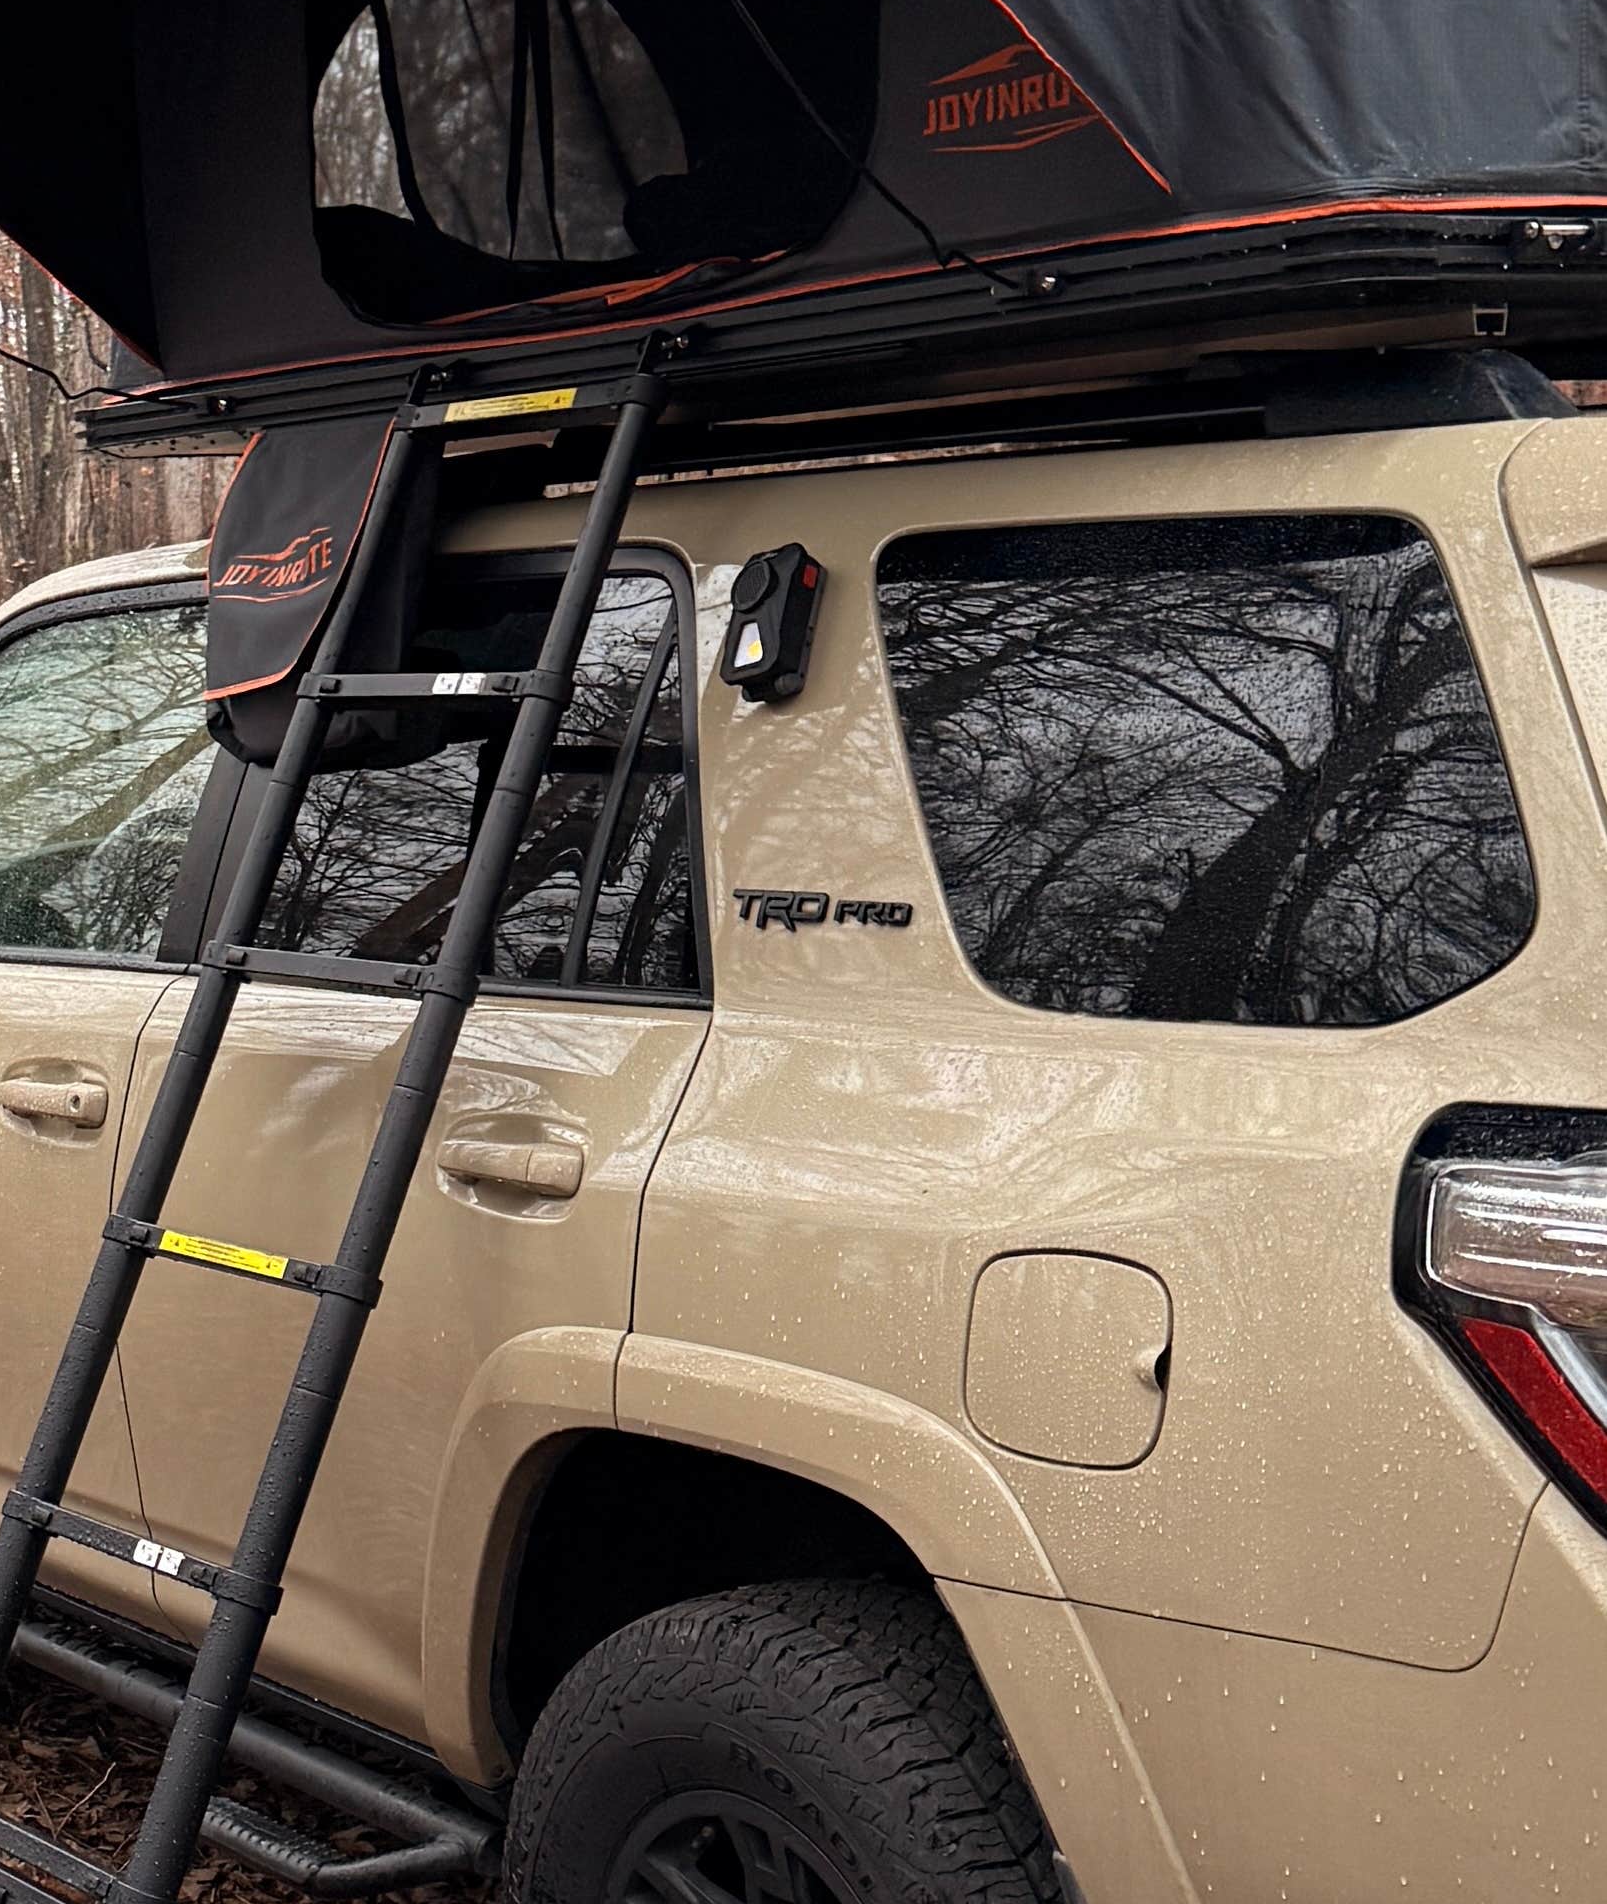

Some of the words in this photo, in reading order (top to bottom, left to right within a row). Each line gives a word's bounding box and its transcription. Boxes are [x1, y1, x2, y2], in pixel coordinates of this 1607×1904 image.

[922, 70, 1071, 137] JOYINRU
[733, 887, 830, 933] TRD
[833, 899, 914, 927] PRO
